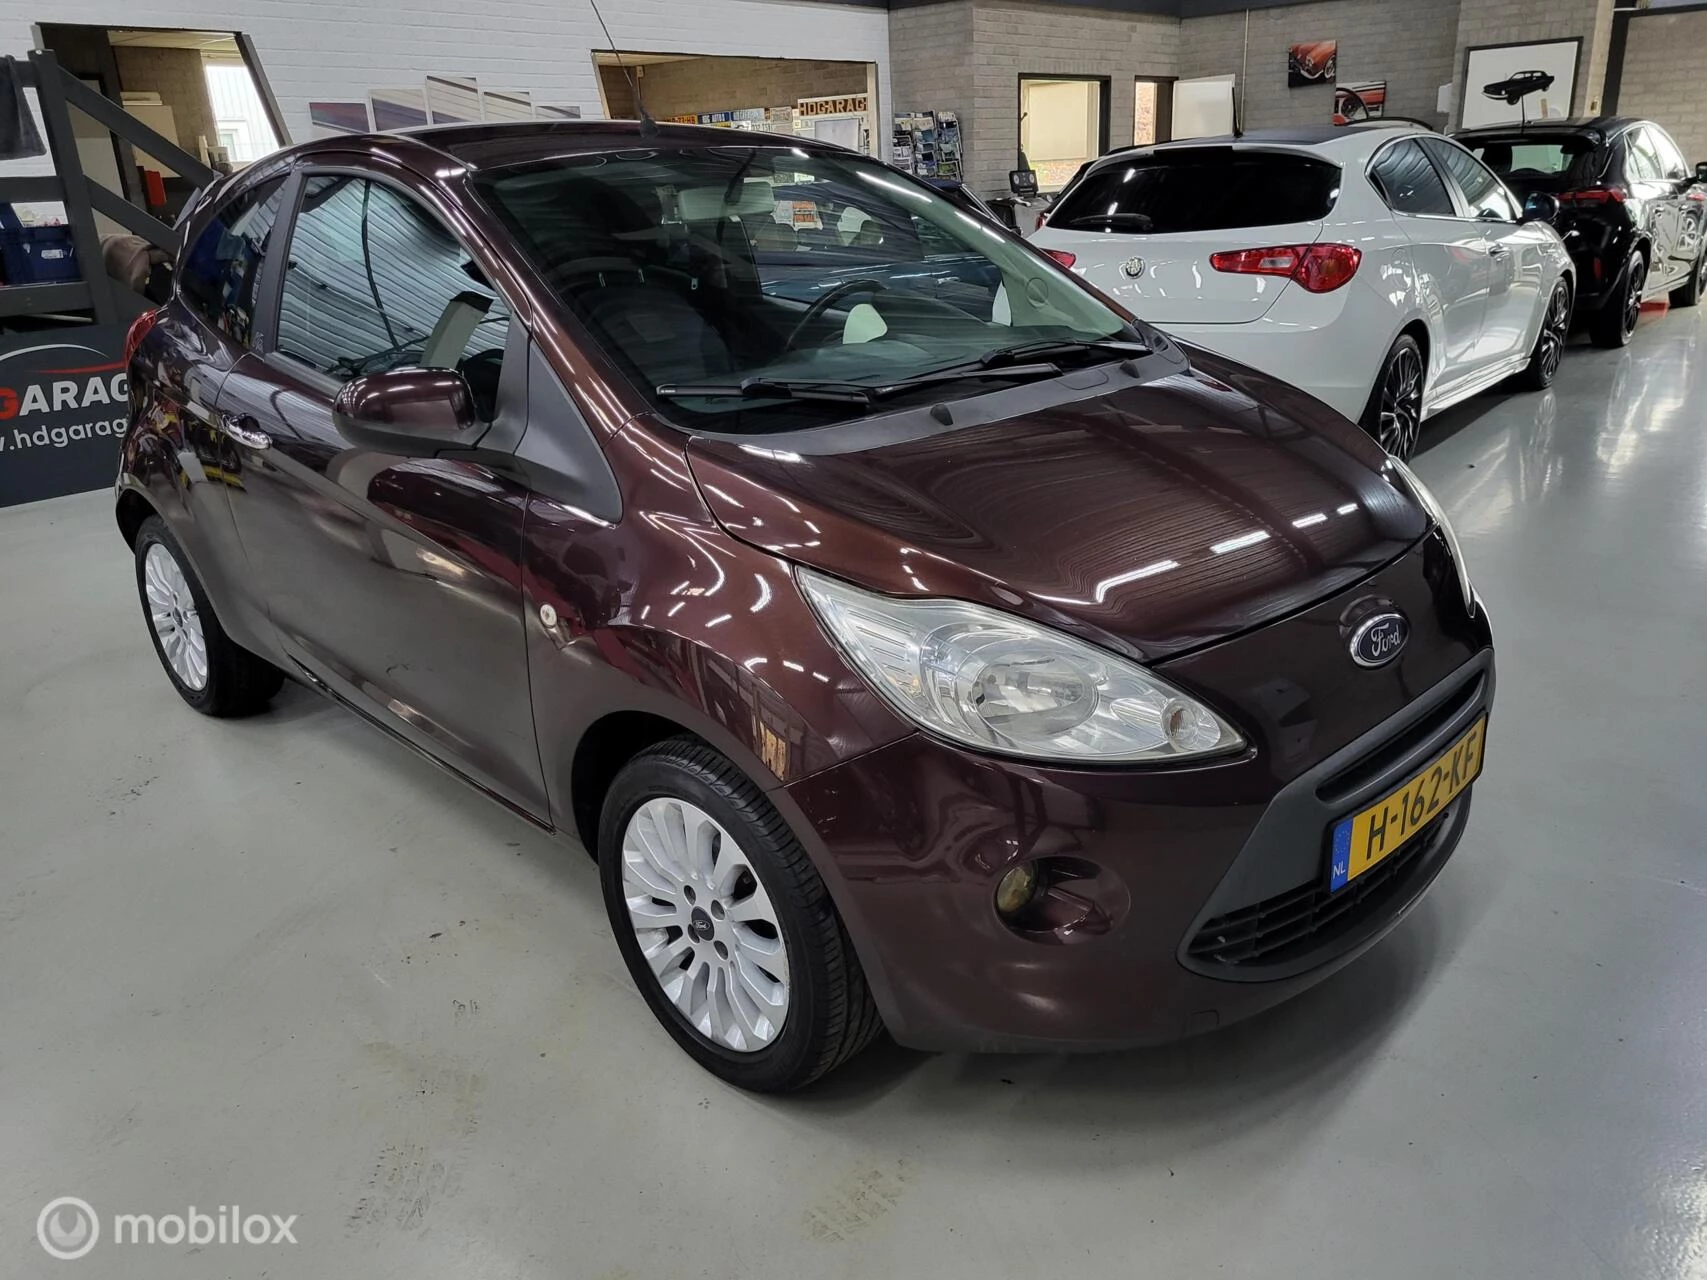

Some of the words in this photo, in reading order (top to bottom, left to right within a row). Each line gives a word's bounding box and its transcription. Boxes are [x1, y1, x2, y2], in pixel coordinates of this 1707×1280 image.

[1370, 622, 1400, 657] Ford
[1366, 731, 1477, 861] H-162-KF
[1332, 860, 1346, 880] NL
